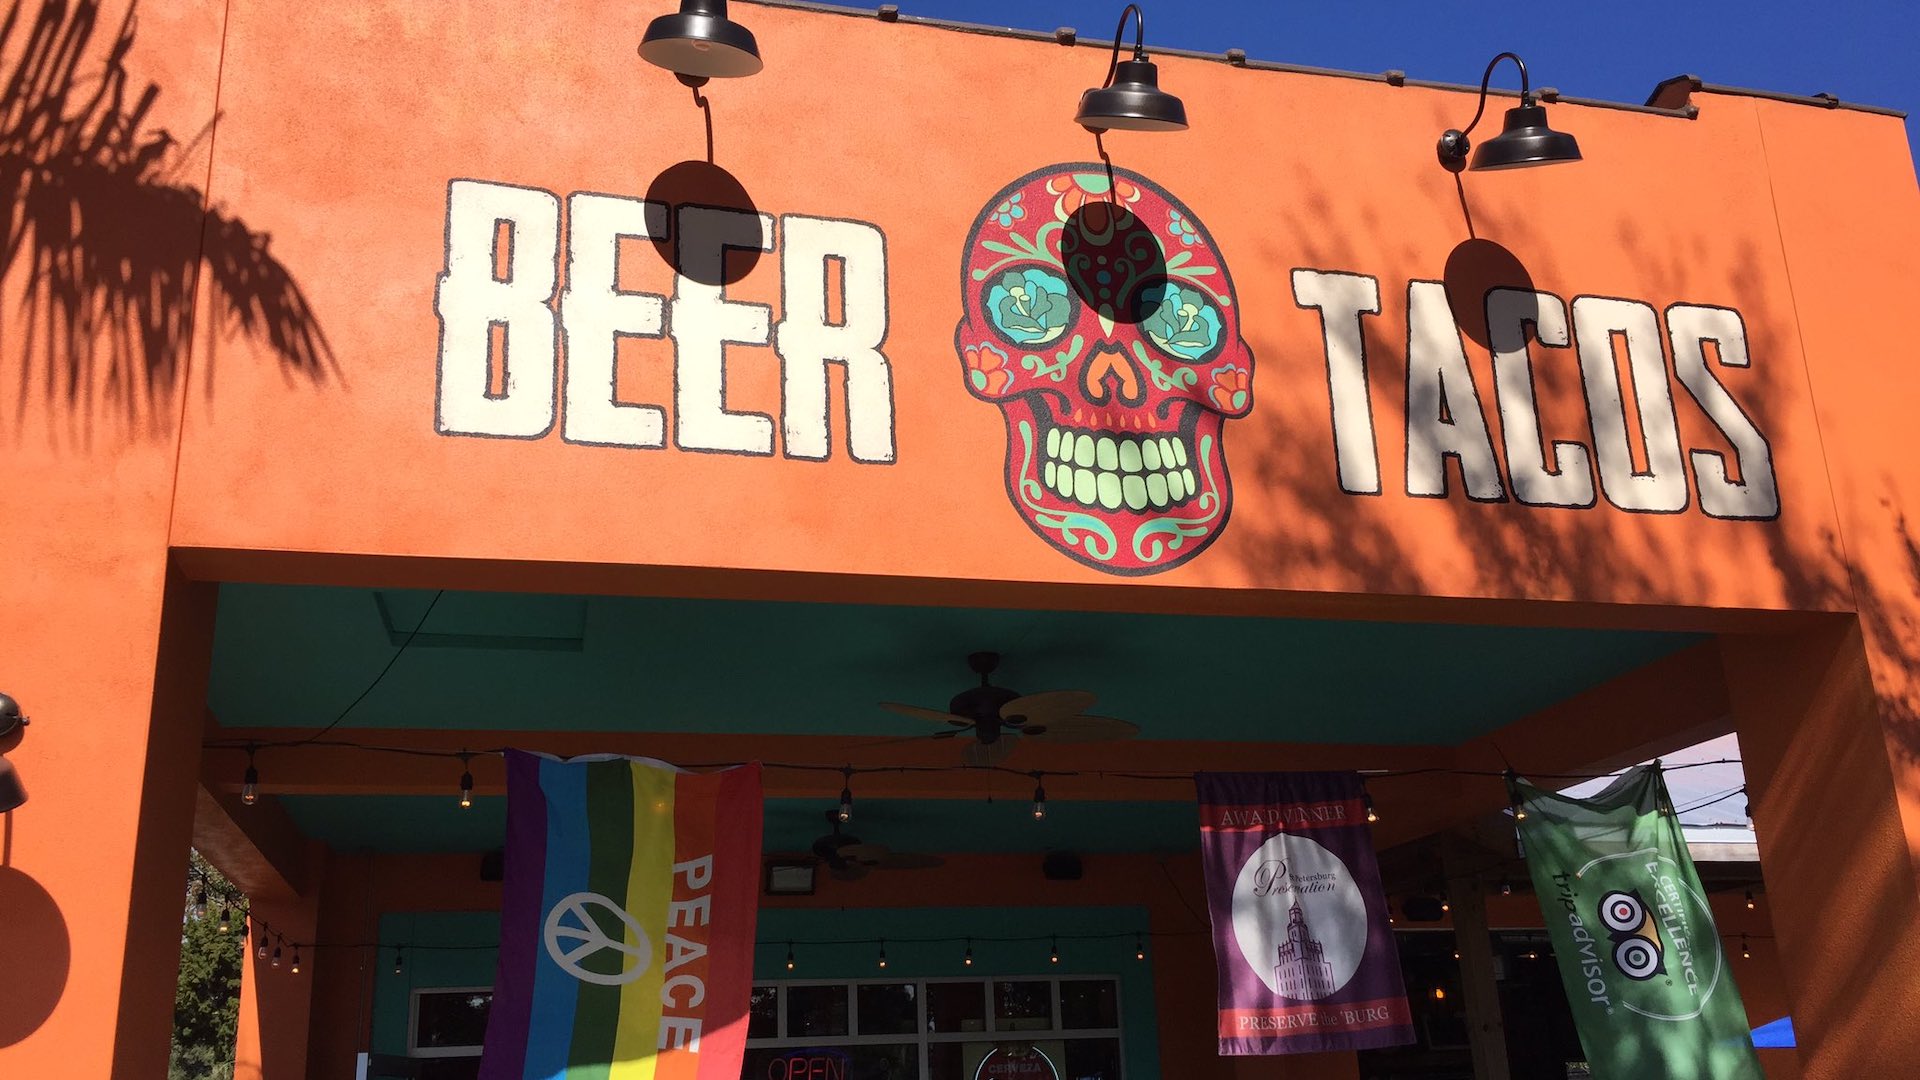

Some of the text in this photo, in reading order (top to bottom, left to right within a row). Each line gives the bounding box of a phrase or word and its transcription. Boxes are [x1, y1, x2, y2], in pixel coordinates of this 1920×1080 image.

[434, 178, 897, 464] BEER
[1290, 268, 1781, 521] TACOS
[1221, 809, 1279, 826] AWAD
[1253, 858, 1336, 897] Preseation
[1645, 861, 1699, 997] EXCELLENCE
[657, 854, 714, 1054] PEACE
[1239, 1013, 1318, 1030] PRESERVE
[1321, 1012, 1338, 1025] the
[768, 1057, 845, 1080] OPEN
[988, 1063, 1042, 1074] CERVEZA
